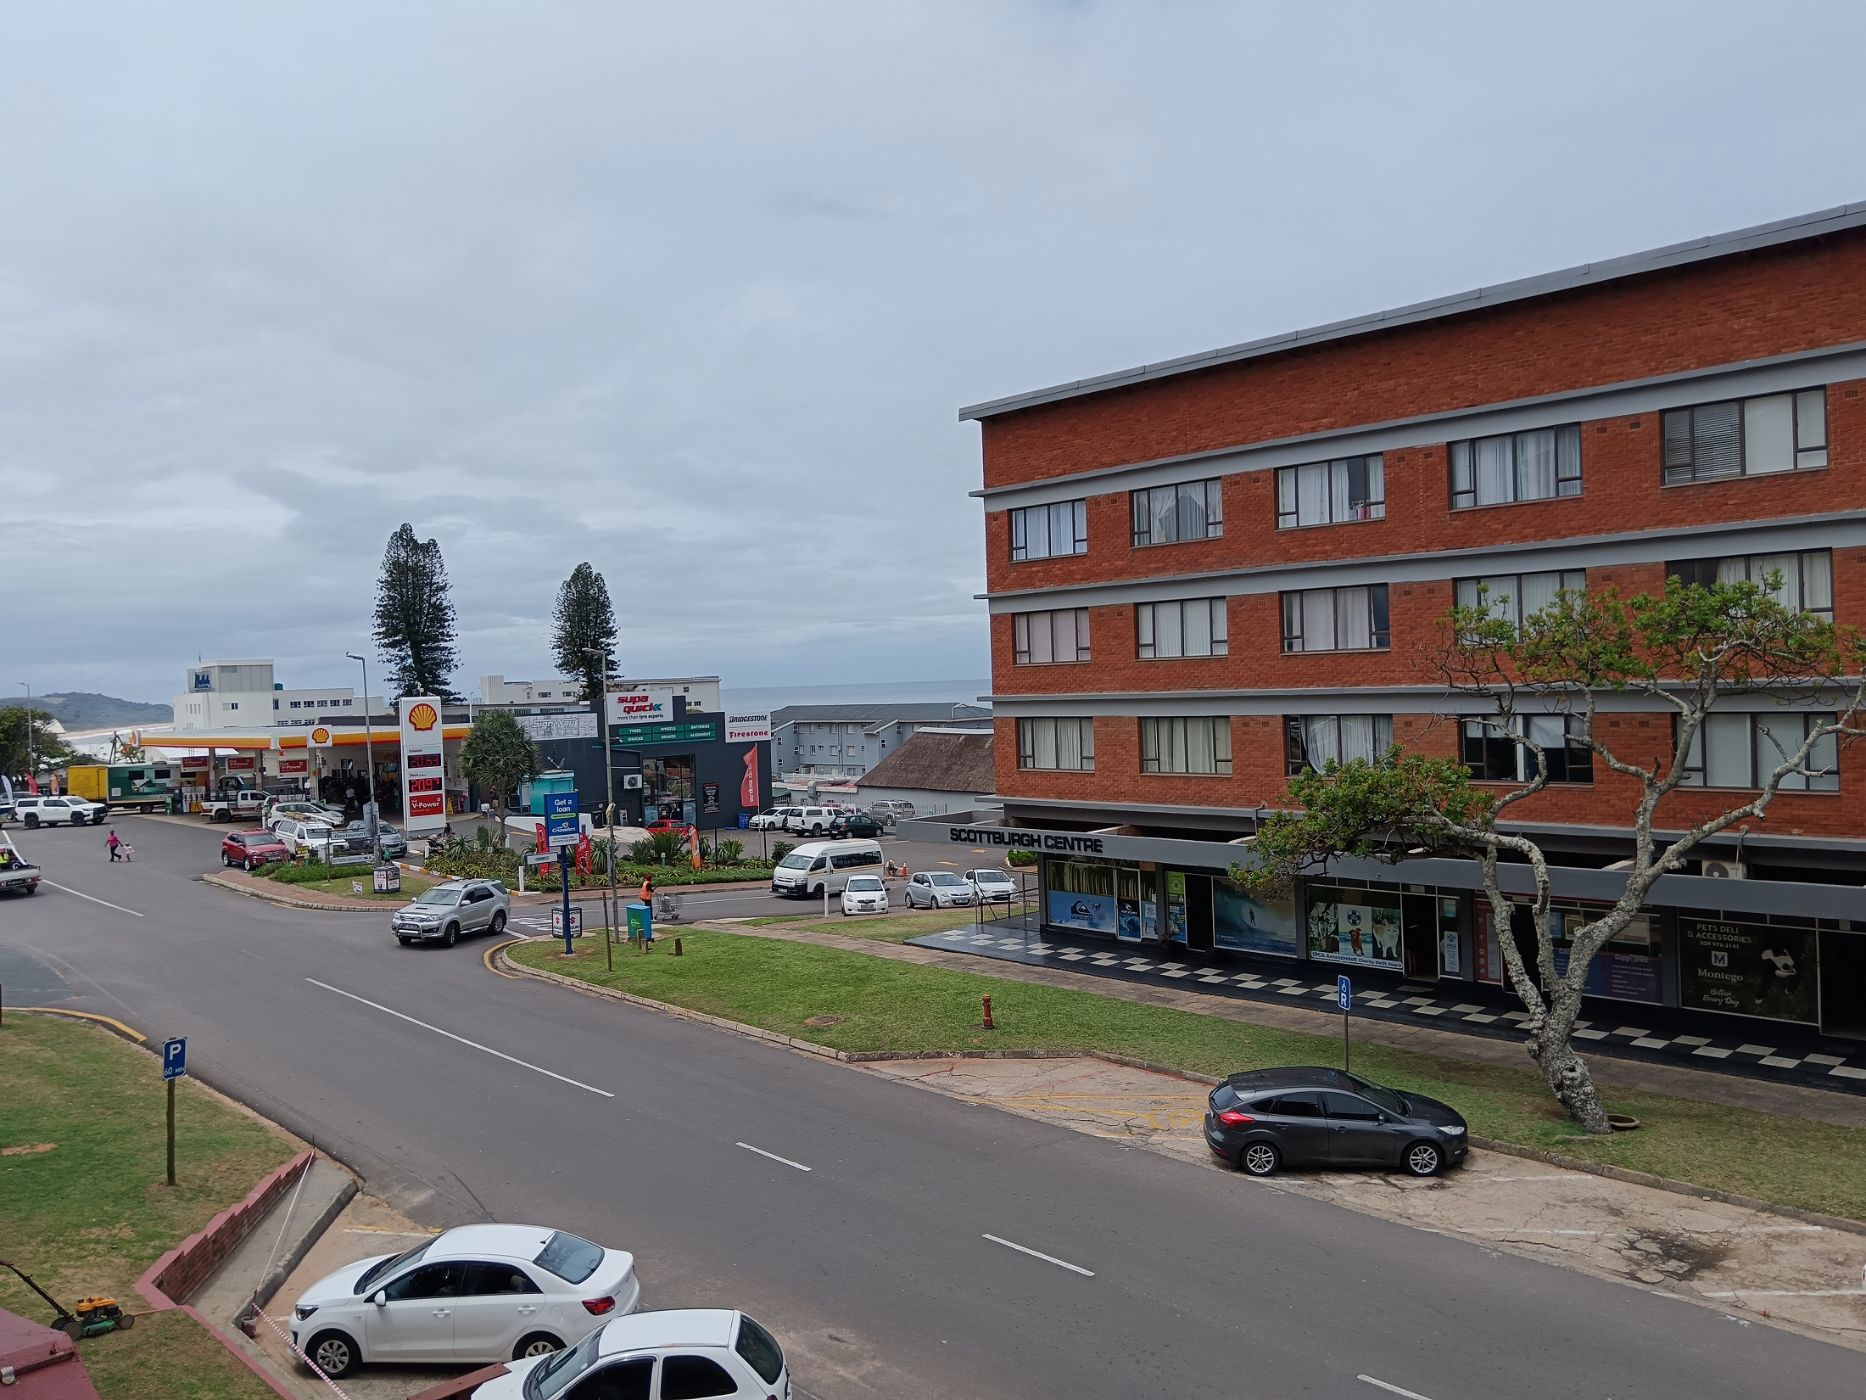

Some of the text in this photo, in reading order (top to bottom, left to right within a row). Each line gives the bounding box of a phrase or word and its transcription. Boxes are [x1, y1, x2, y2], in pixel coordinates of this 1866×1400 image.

[617, 694, 649, 704] supa
[623, 702, 663, 713] quick
[728, 714, 768, 723] BRIDGESTONE
[728, 730, 769, 739] Firestone
[411, 801, 440, 809] V-Power
[950, 827, 1103, 853] SCOTTBURGH CENTRE
[1696, 923, 1739, 934] PETS DELI
[1687, 930, 1752, 944] & ACCESSORIES
[1714, 954, 1727, 965] M
[1697, 967, 1744, 983] Montego
[1340, 992, 1347, 1007] R
[1724, 996, 1740, 1007] Day
[169, 1043, 182, 1061] P
[164, 1066, 173, 1076] 60
